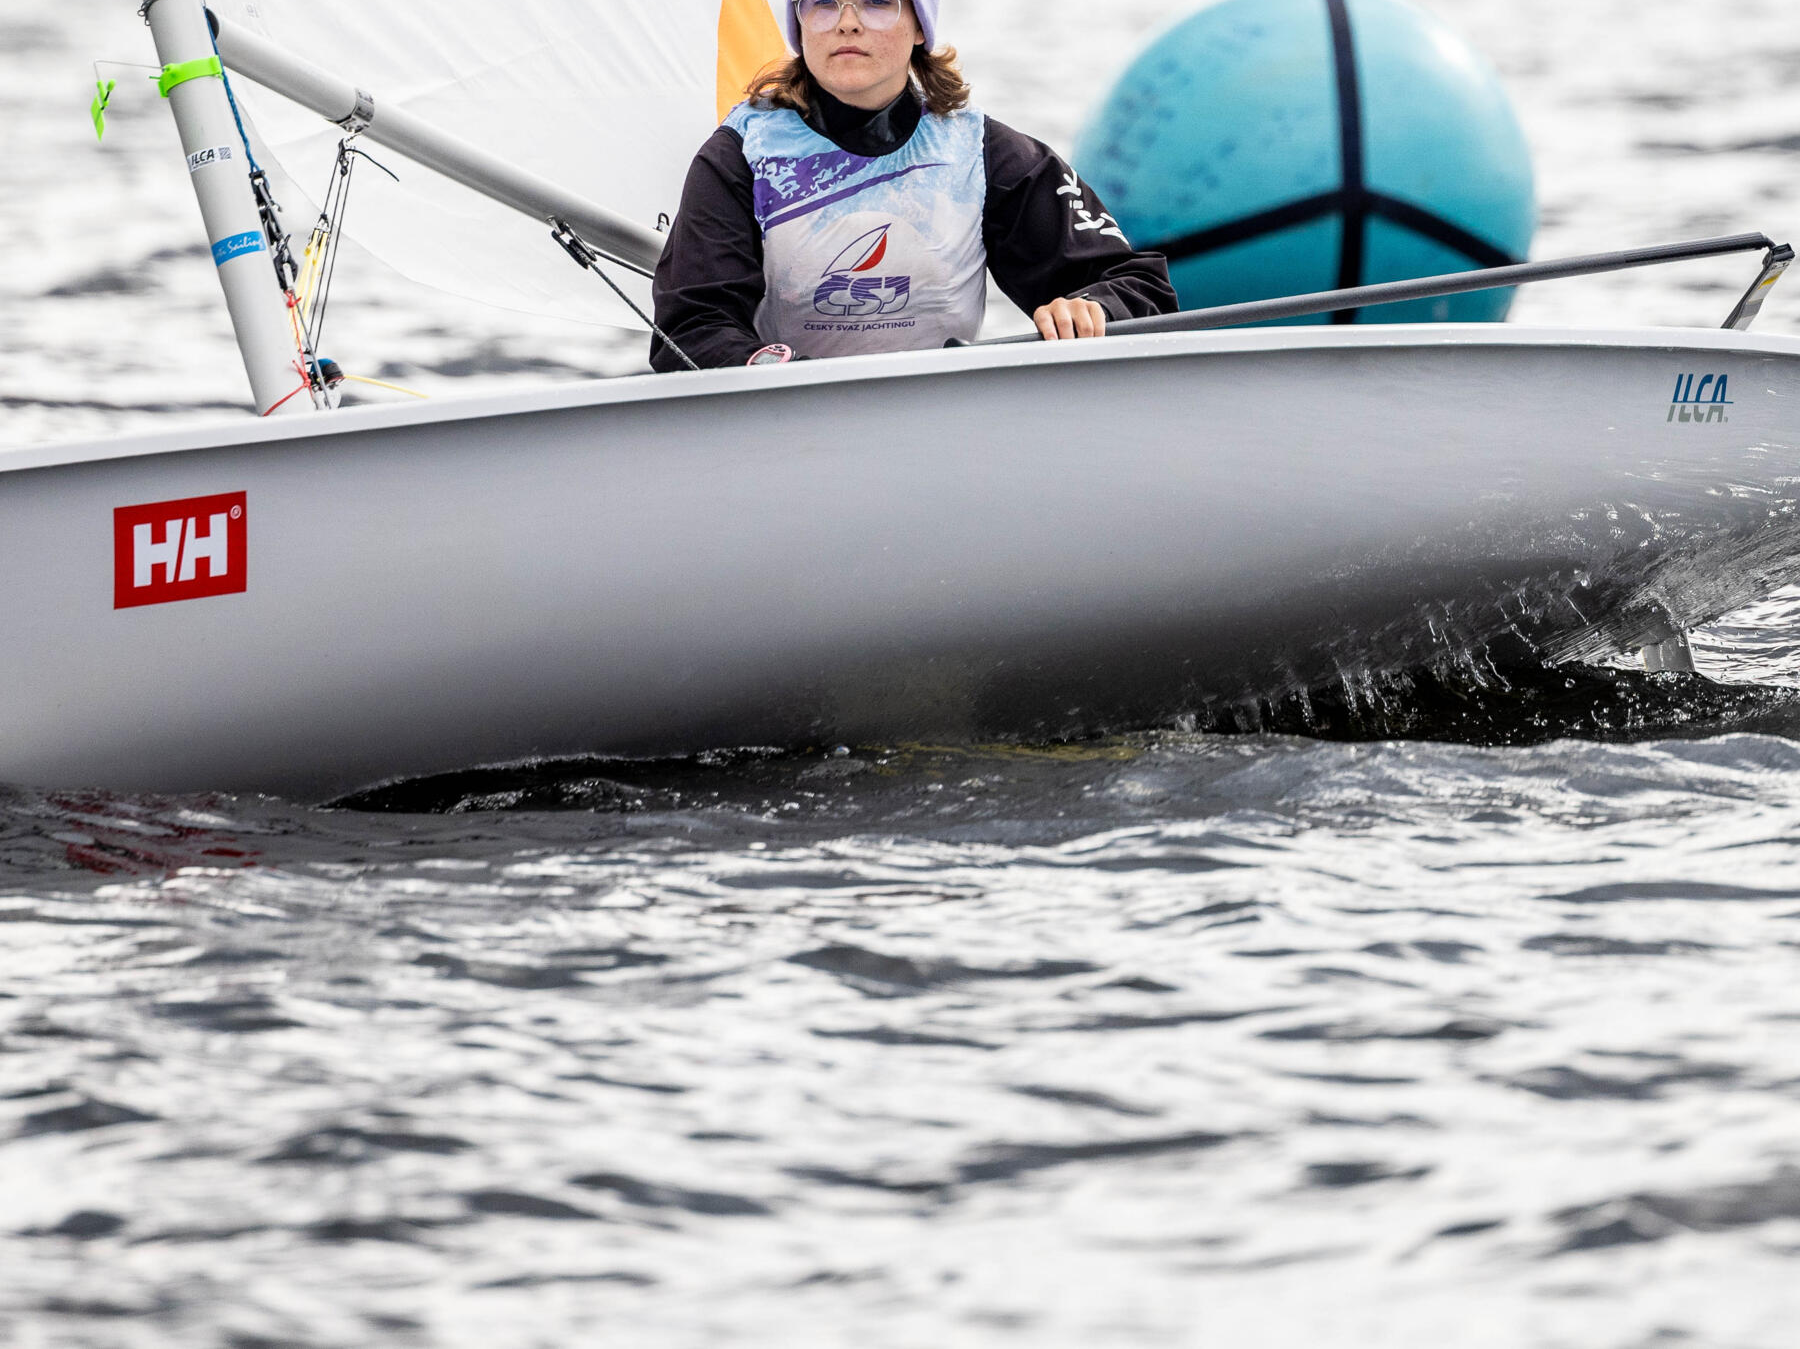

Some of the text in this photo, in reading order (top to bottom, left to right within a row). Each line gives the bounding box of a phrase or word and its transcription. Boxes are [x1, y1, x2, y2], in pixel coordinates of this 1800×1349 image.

[191, 148, 215, 166] ILCA
[836, 323, 860, 331] SVAZ
[861, 320, 916, 332] JACHTINGU
[1667, 373, 1733, 422] ILCA
[133, 512, 229, 589] HH
